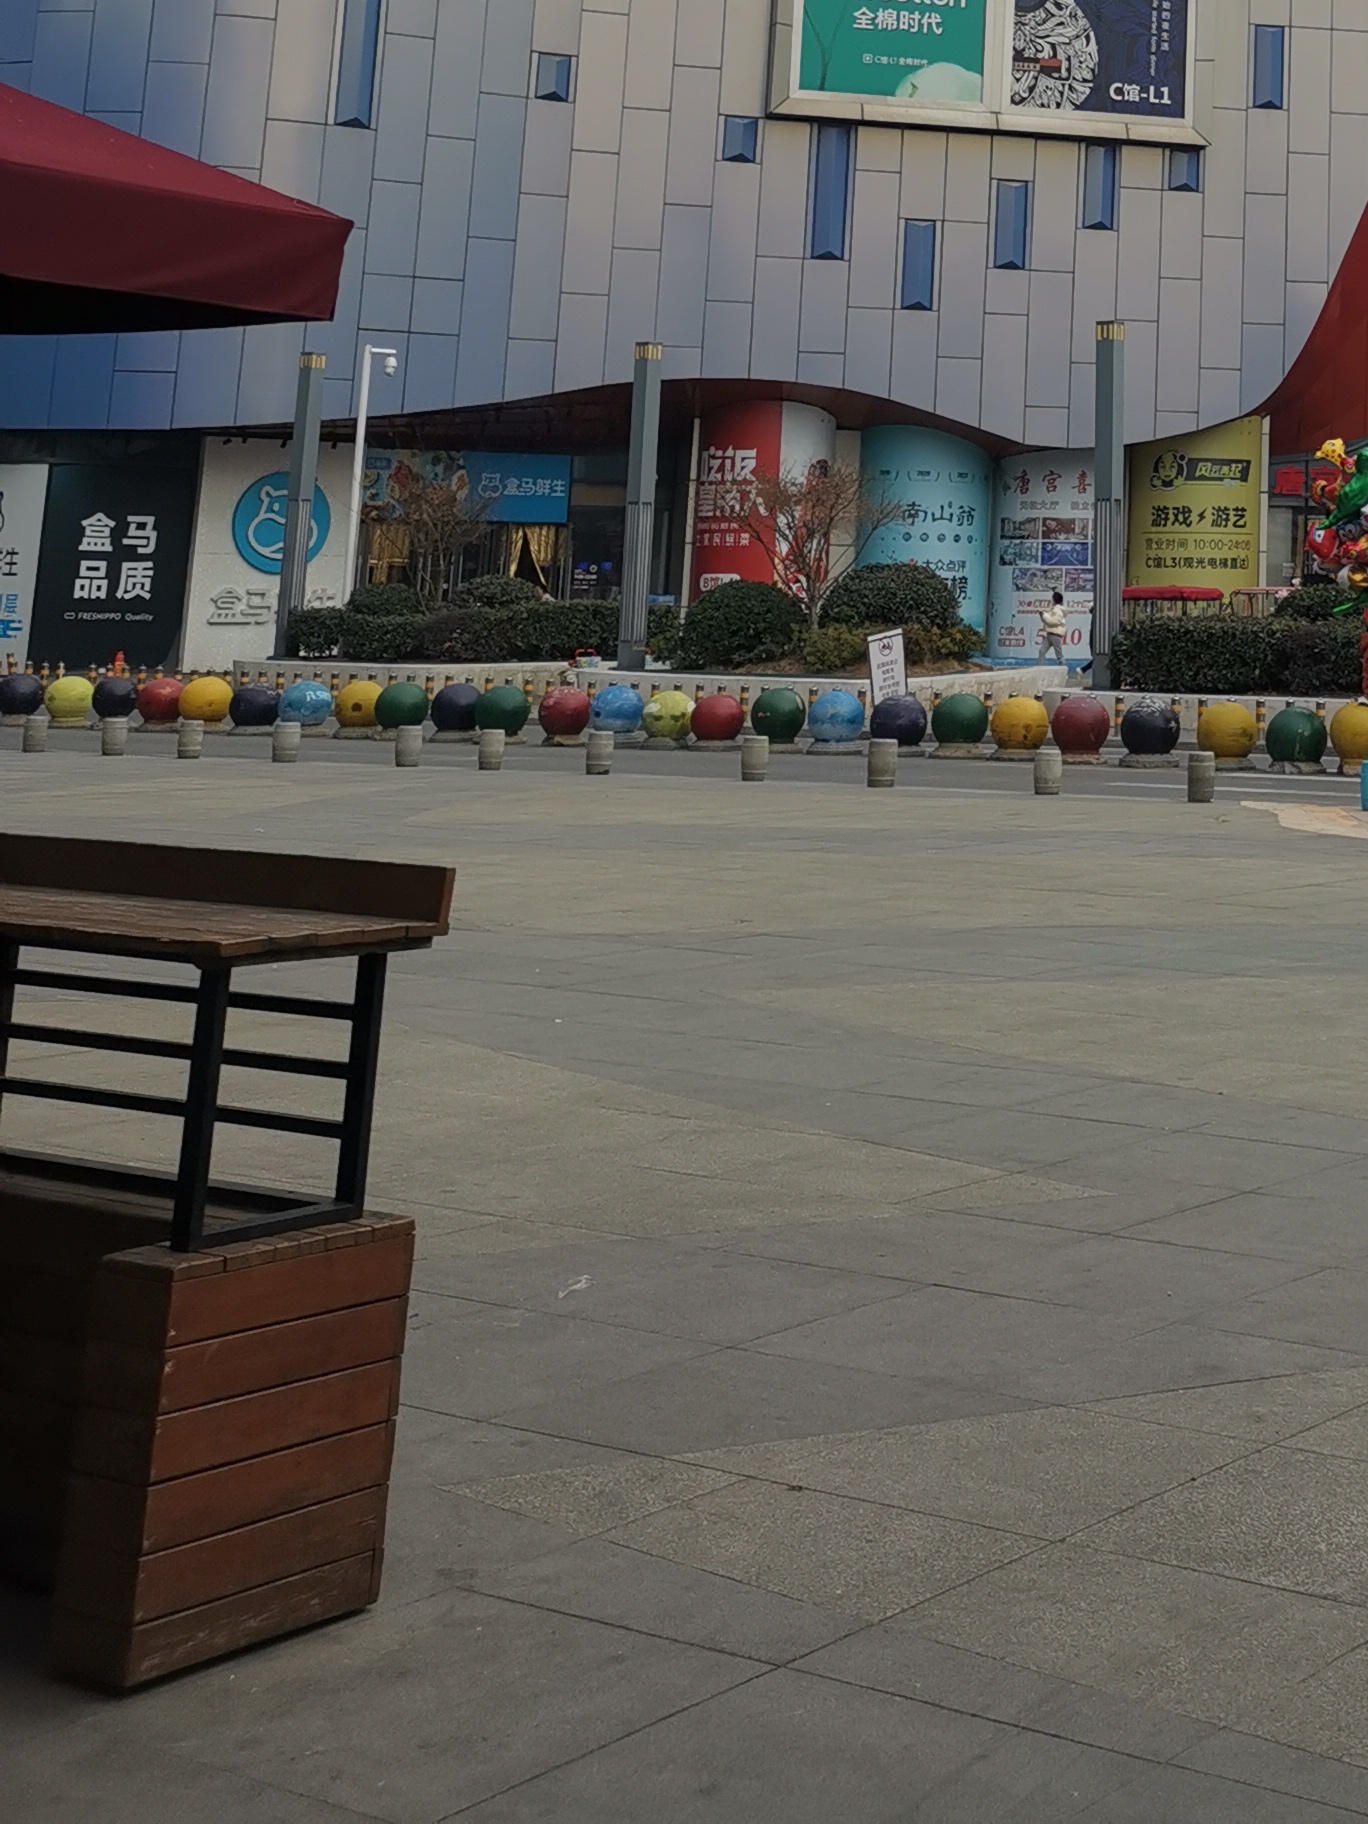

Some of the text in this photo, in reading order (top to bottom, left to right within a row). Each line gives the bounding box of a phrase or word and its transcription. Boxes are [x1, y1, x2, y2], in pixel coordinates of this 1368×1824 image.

[853, 7, 943, 35] 全棉时代
[1109, 82, 1172, 105] C馆-L1
[503, 477, 566, 497] 盒马鲜生
[1151, 505, 1248, 528] 游戏 游艺
[78, 512, 157, 554] 盒马
[1145, 538, 1189, 551] 营业时间
[73, 560, 154, 600] 品质
[125, 613, 154, 622] Quality
